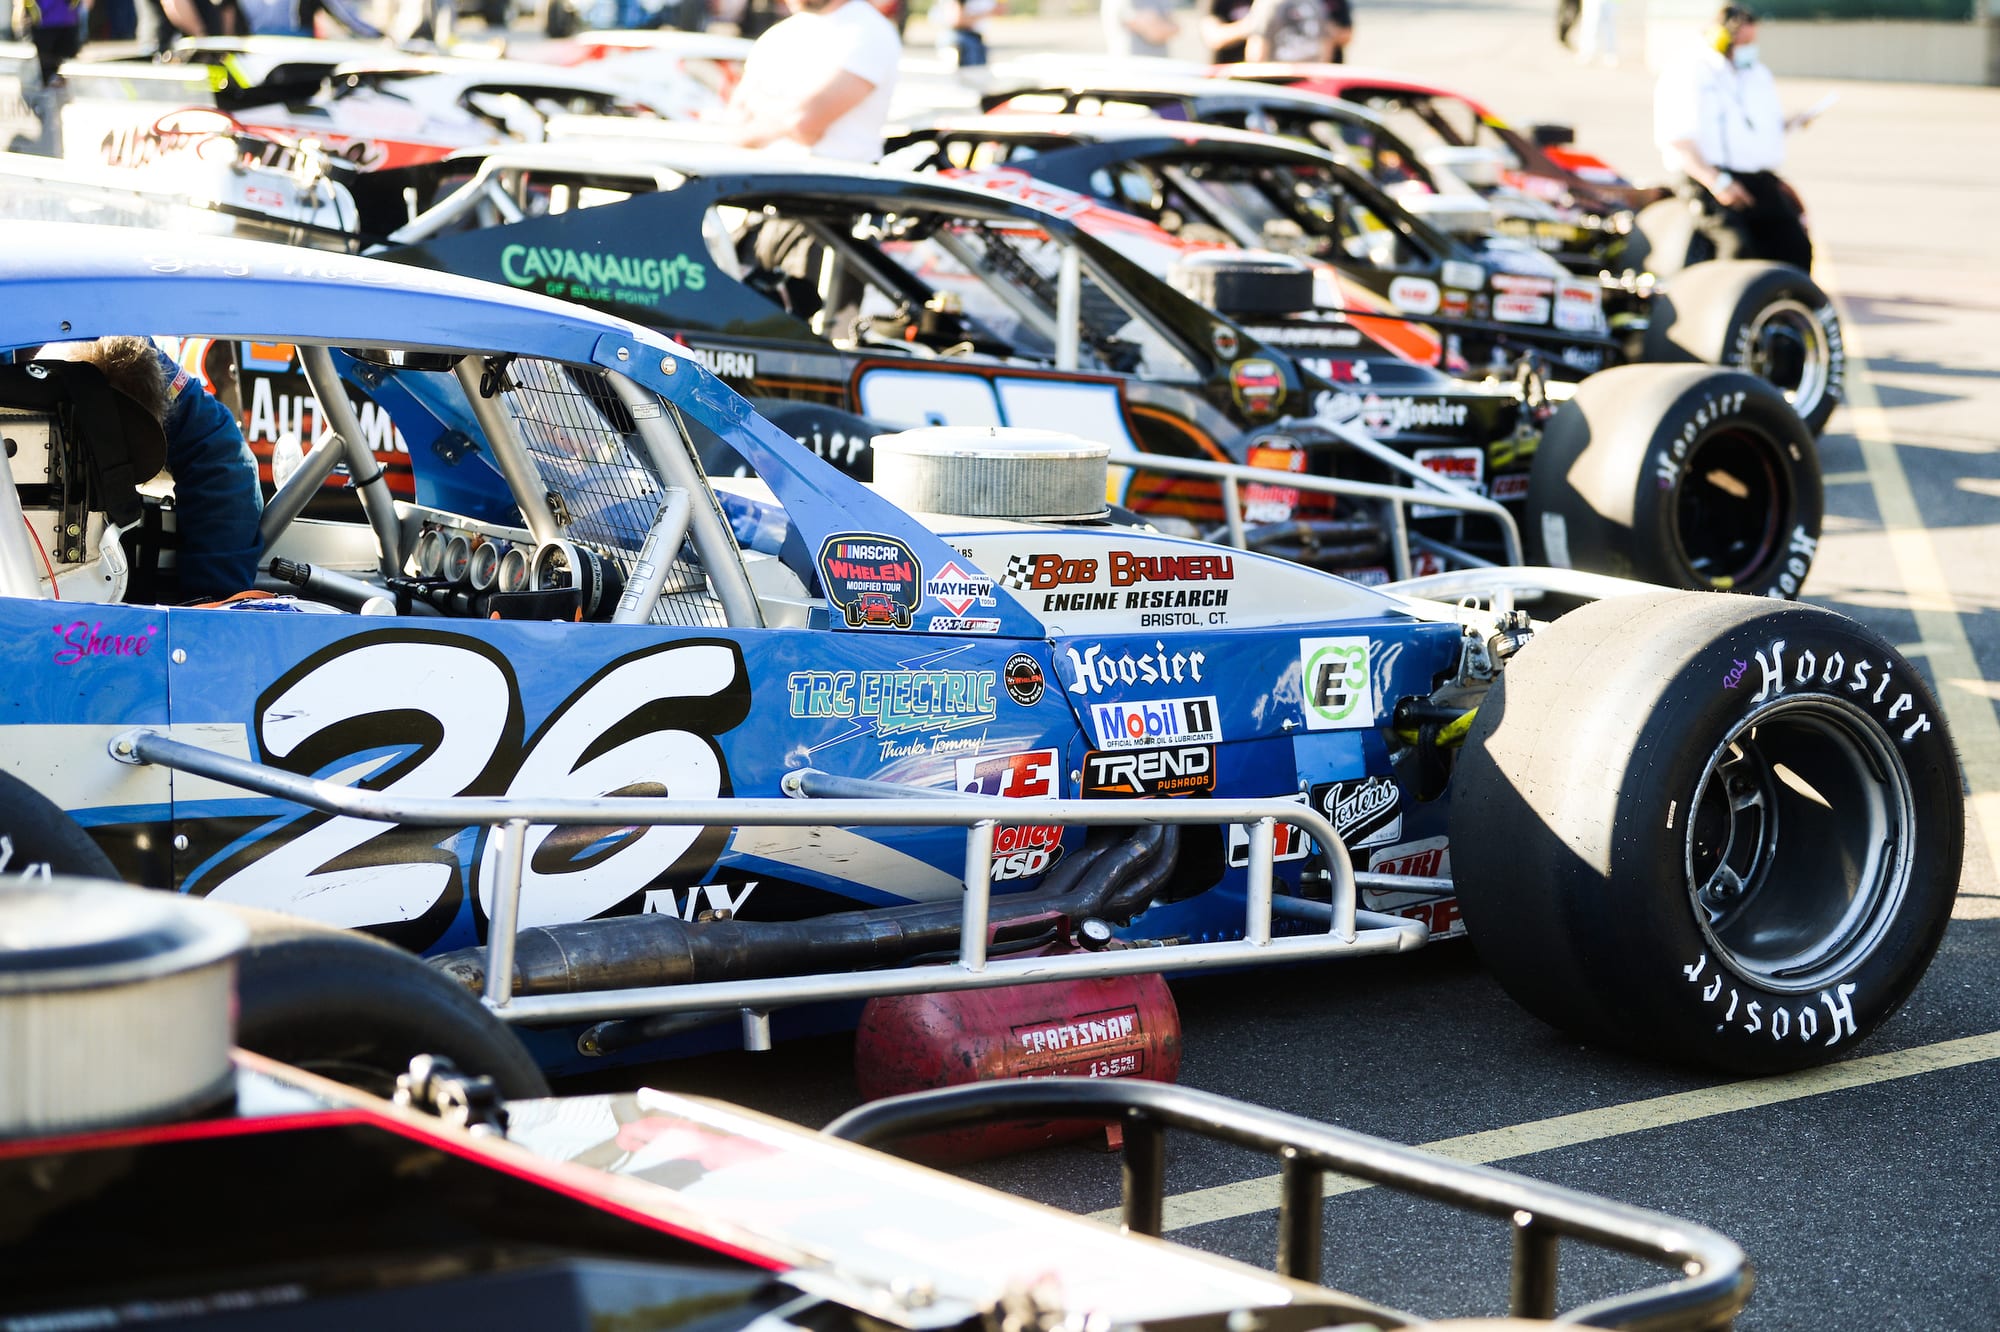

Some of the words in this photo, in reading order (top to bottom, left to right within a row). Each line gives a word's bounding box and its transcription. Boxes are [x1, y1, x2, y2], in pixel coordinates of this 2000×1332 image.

[570, 285, 612, 301] BLUE
[614, 289, 660, 306] POINT
[827, 558, 913, 582] WHELEN
[852, 545, 899, 562] NASCAR
[846, 580, 881, 592] MODIFIED
[881, 581, 901, 593] TOUR
[927, 582, 991, 596] MAYHEW
[1043, 592, 1120, 612] ENGINE
[1125, 588, 1229, 610] RESEARCH
[1140, 613, 1204, 628] BRISTOL,
[1208, 611, 1229, 625] CT.
[53, 621, 152, 667] Sheree
[1007, 656, 1038, 671] WINNER
[1066, 639, 1206, 695] Hoosier
[787, 670, 856, 718] TRC
[860, 670, 996, 739] ELECTRIC
[1750, 640, 1931, 740] Hoosier
[1100, 703, 1178, 739] Mobil
[1174, 733, 1214, 743] LUBRICANTS
[878, 737, 927, 763] Thanks
[930, 728, 988, 757] Tommy!
[1090, 747, 1210, 793] TREND
[1157, 775, 1210, 791] PUSHRODS
[199, 641, 737, 942] 26
[1324, 779, 1401, 828] Jostens
[642, 882, 760, 923] NY
[1683, 954, 1858, 1047] Hoosier
[1021, 1015, 1132, 1055] CRAFTSMAN
[1089, 1060, 1120, 1078] 135
